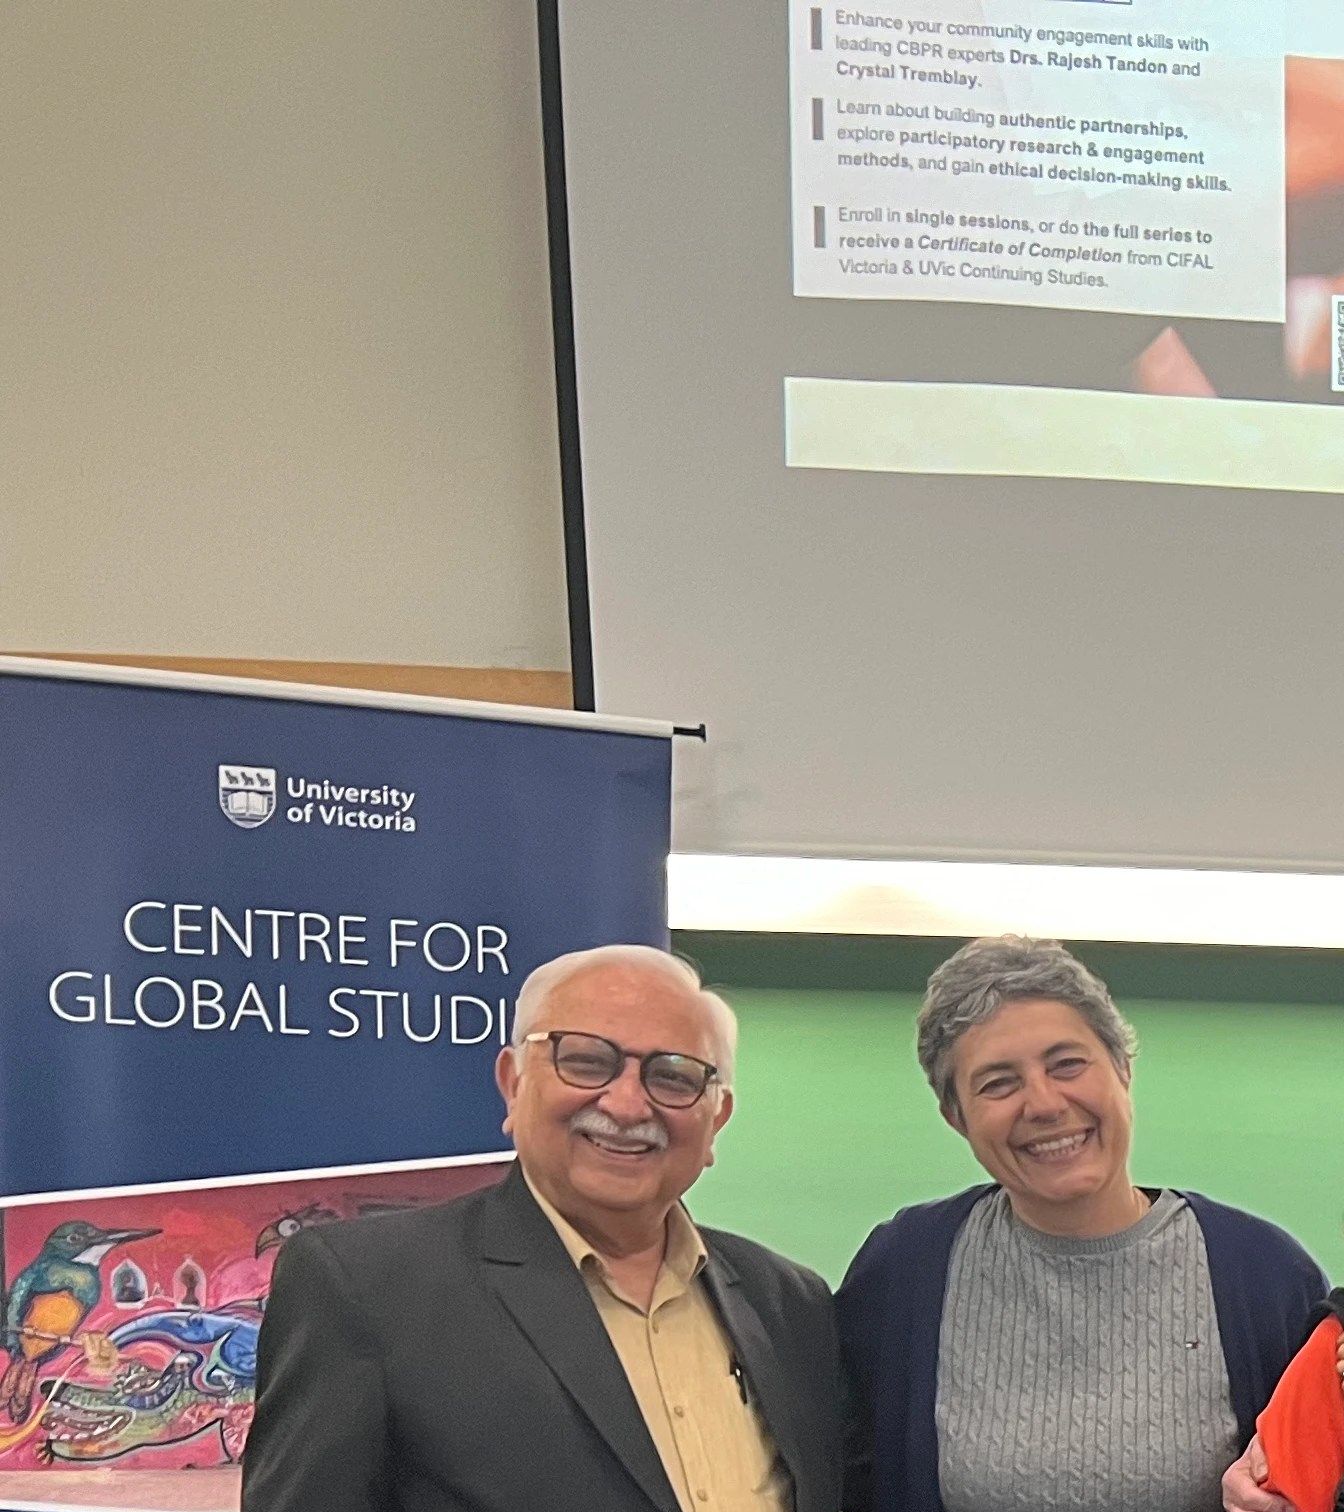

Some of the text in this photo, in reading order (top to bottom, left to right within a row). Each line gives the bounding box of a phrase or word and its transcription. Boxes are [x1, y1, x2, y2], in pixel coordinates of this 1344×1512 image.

[835, 9, 1209, 52] Enhance your community engagement skills with
[835, 35, 1200, 77] leading CBPR experts Drs. Rajesh Tandon and
[837, 60, 982, 90] Crystal Tremblay.
[837, 98, 1188, 140] Learn about building authentic partnerships,
[837, 127, 1205, 164] explore participatory research & engagement
[837, 152, 1232, 192] methods, and gain ethical decision-making skills.
[838, 207, 1213, 244] Enroll in single sessions, or do the full series to
[839, 234, 1214, 270] receive a Certificate of Completion from CIFAL
[839, 258, 1109, 288] Victoria & UVic Continuing Studies.
[286, 776, 416, 810] University
[287, 802, 417, 833] of Victoria
[123, 901, 510, 975] CENTRE FOR
[48, 971, 507, 1046] GLOBAL STUDI
